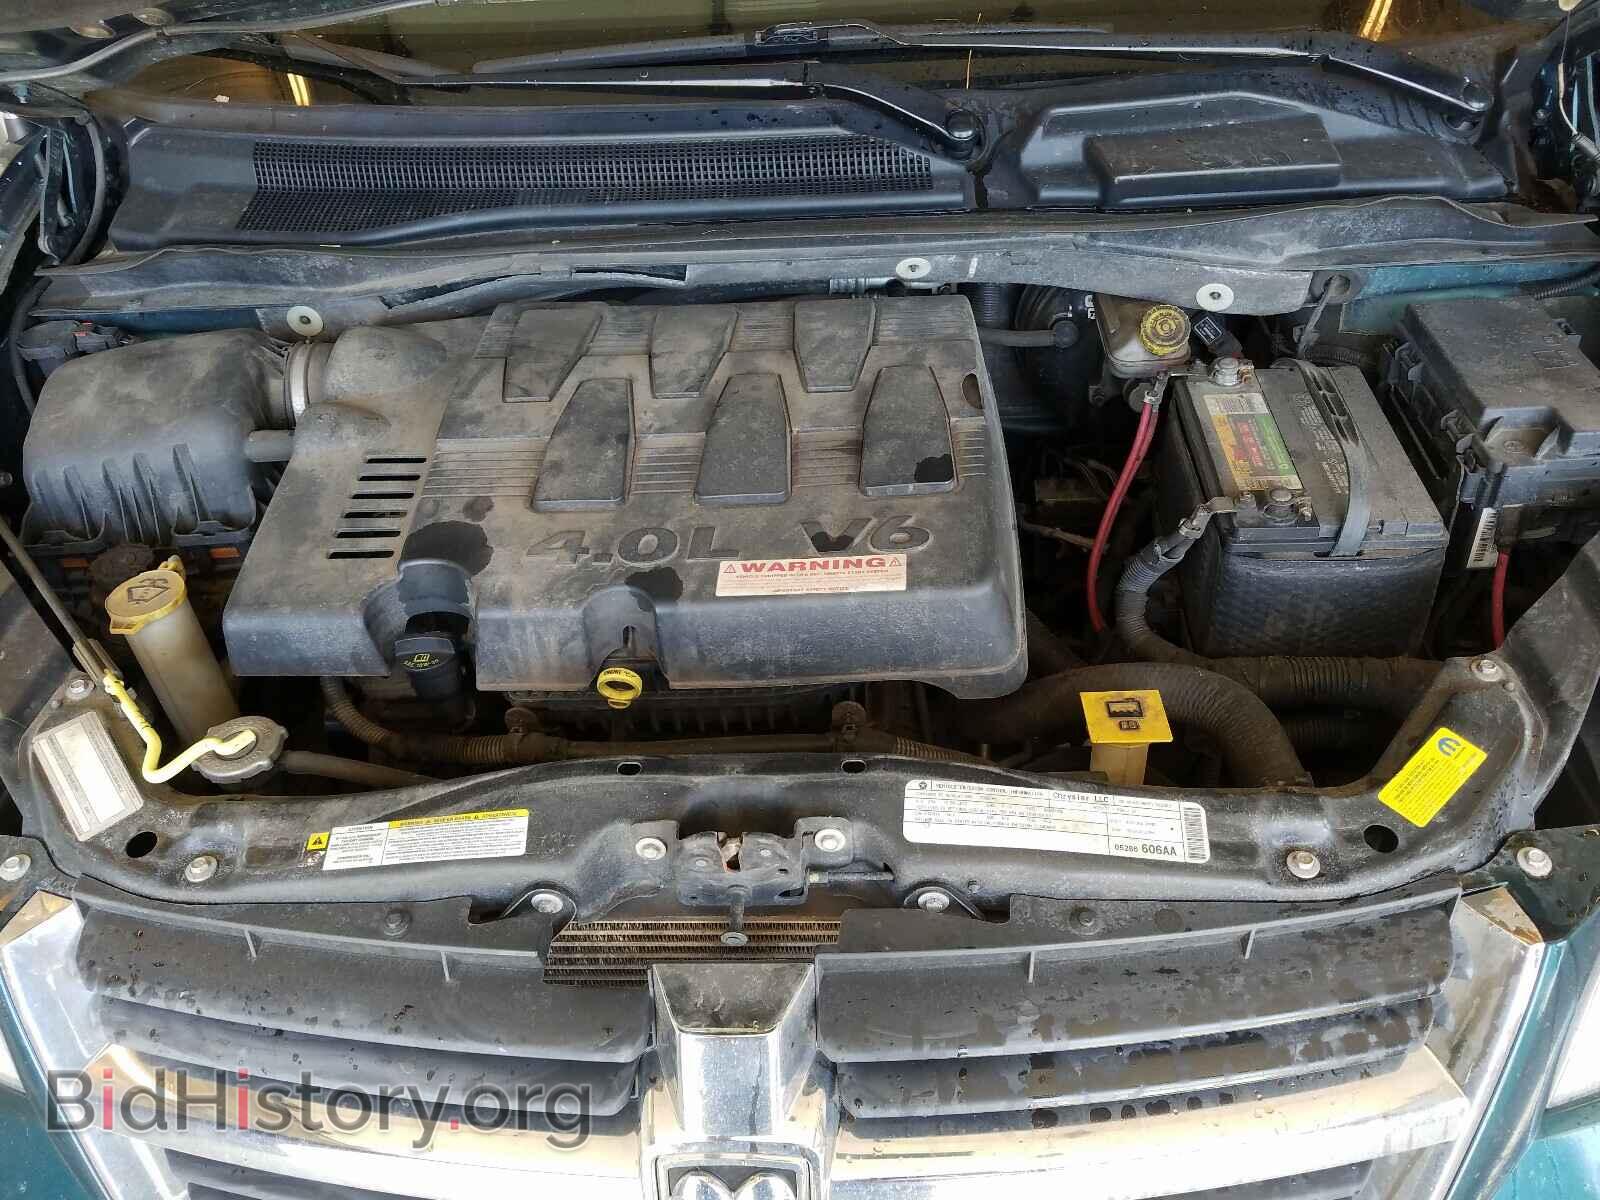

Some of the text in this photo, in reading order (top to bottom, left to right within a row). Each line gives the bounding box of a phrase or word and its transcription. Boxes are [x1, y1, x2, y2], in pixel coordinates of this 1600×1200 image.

[526, 515, 933, 567] 4.0L V6
[740, 557, 886, 573] WARNING
[1053, 791, 1089, 801] Chrysler
[1141, 843, 1177, 857] 606AA
